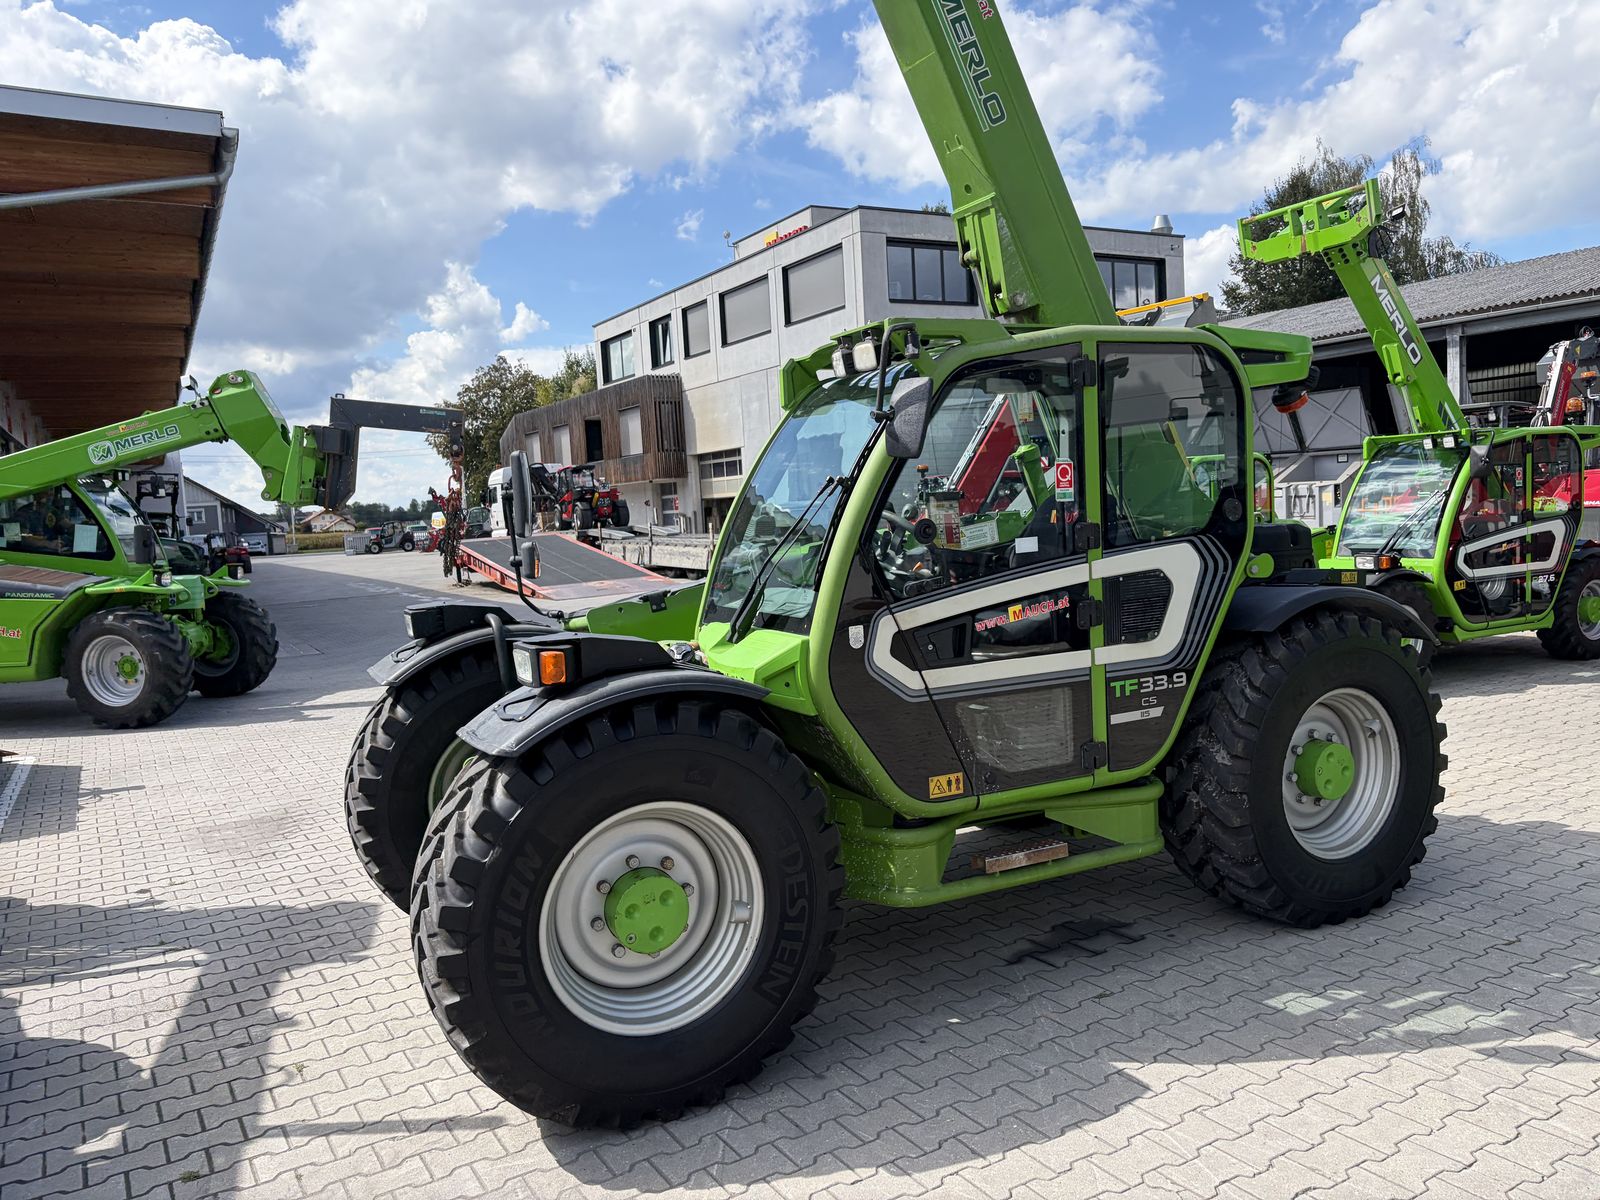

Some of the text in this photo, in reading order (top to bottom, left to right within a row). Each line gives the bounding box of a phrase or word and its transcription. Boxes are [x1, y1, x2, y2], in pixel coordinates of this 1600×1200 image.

[1370, 273, 1422, 366] MERLO
[114, 424, 180, 452] MERLO
[5, 591, 56, 599] PANORAMIC
[1110, 671, 1187, 698] TF33.9
[1141, 695, 1158, 706] CS
